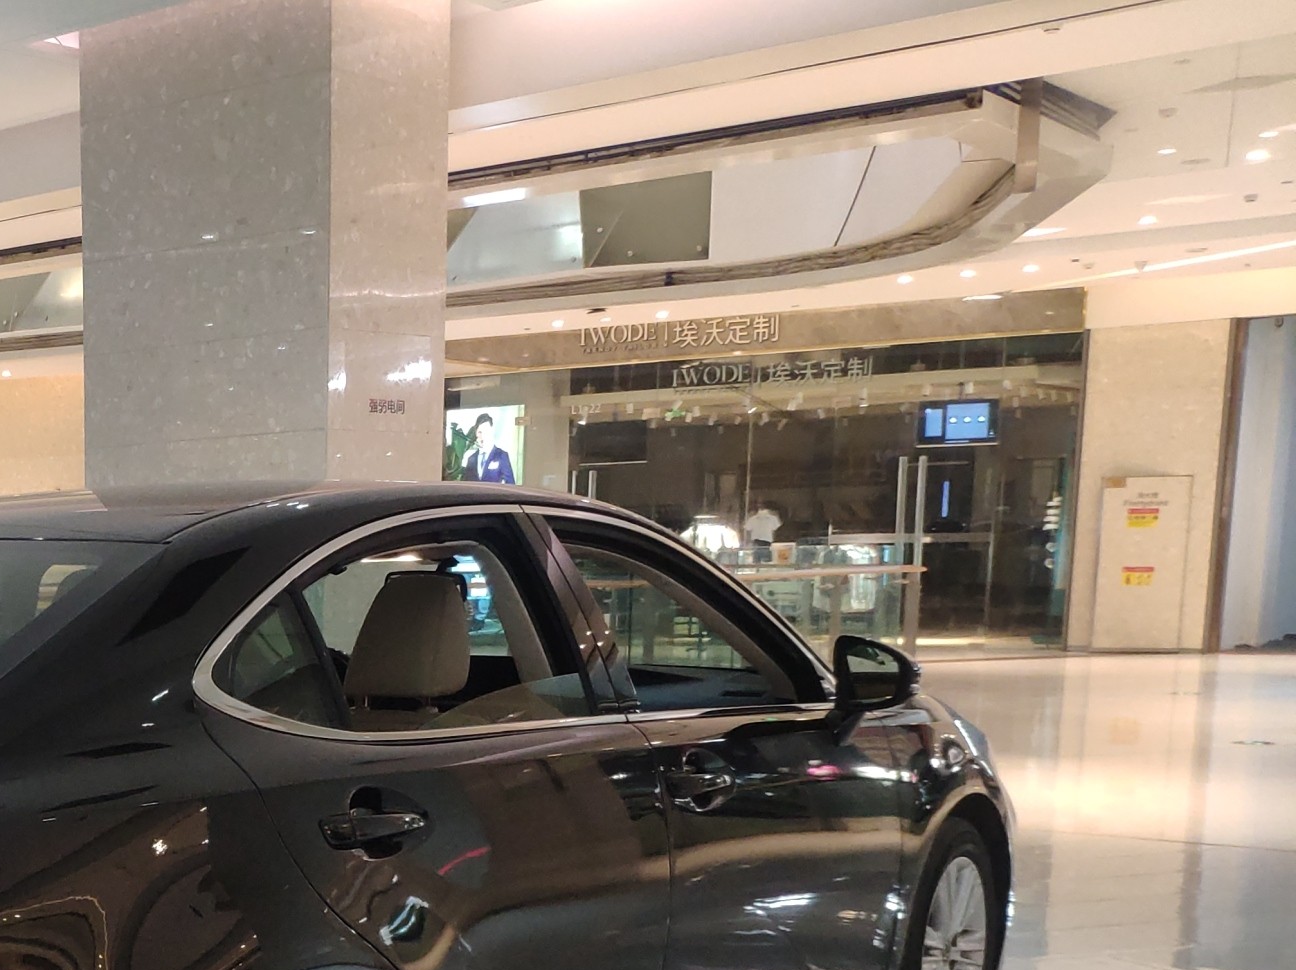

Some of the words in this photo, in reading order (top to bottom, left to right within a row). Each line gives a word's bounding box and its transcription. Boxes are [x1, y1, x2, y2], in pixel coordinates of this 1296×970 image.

[578, 323, 657, 346] IWODE
[672, 314, 780, 347] 埃沃定制
[672, 363, 752, 387] IWODE
[768, 357, 873, 386] 埃沃定制
